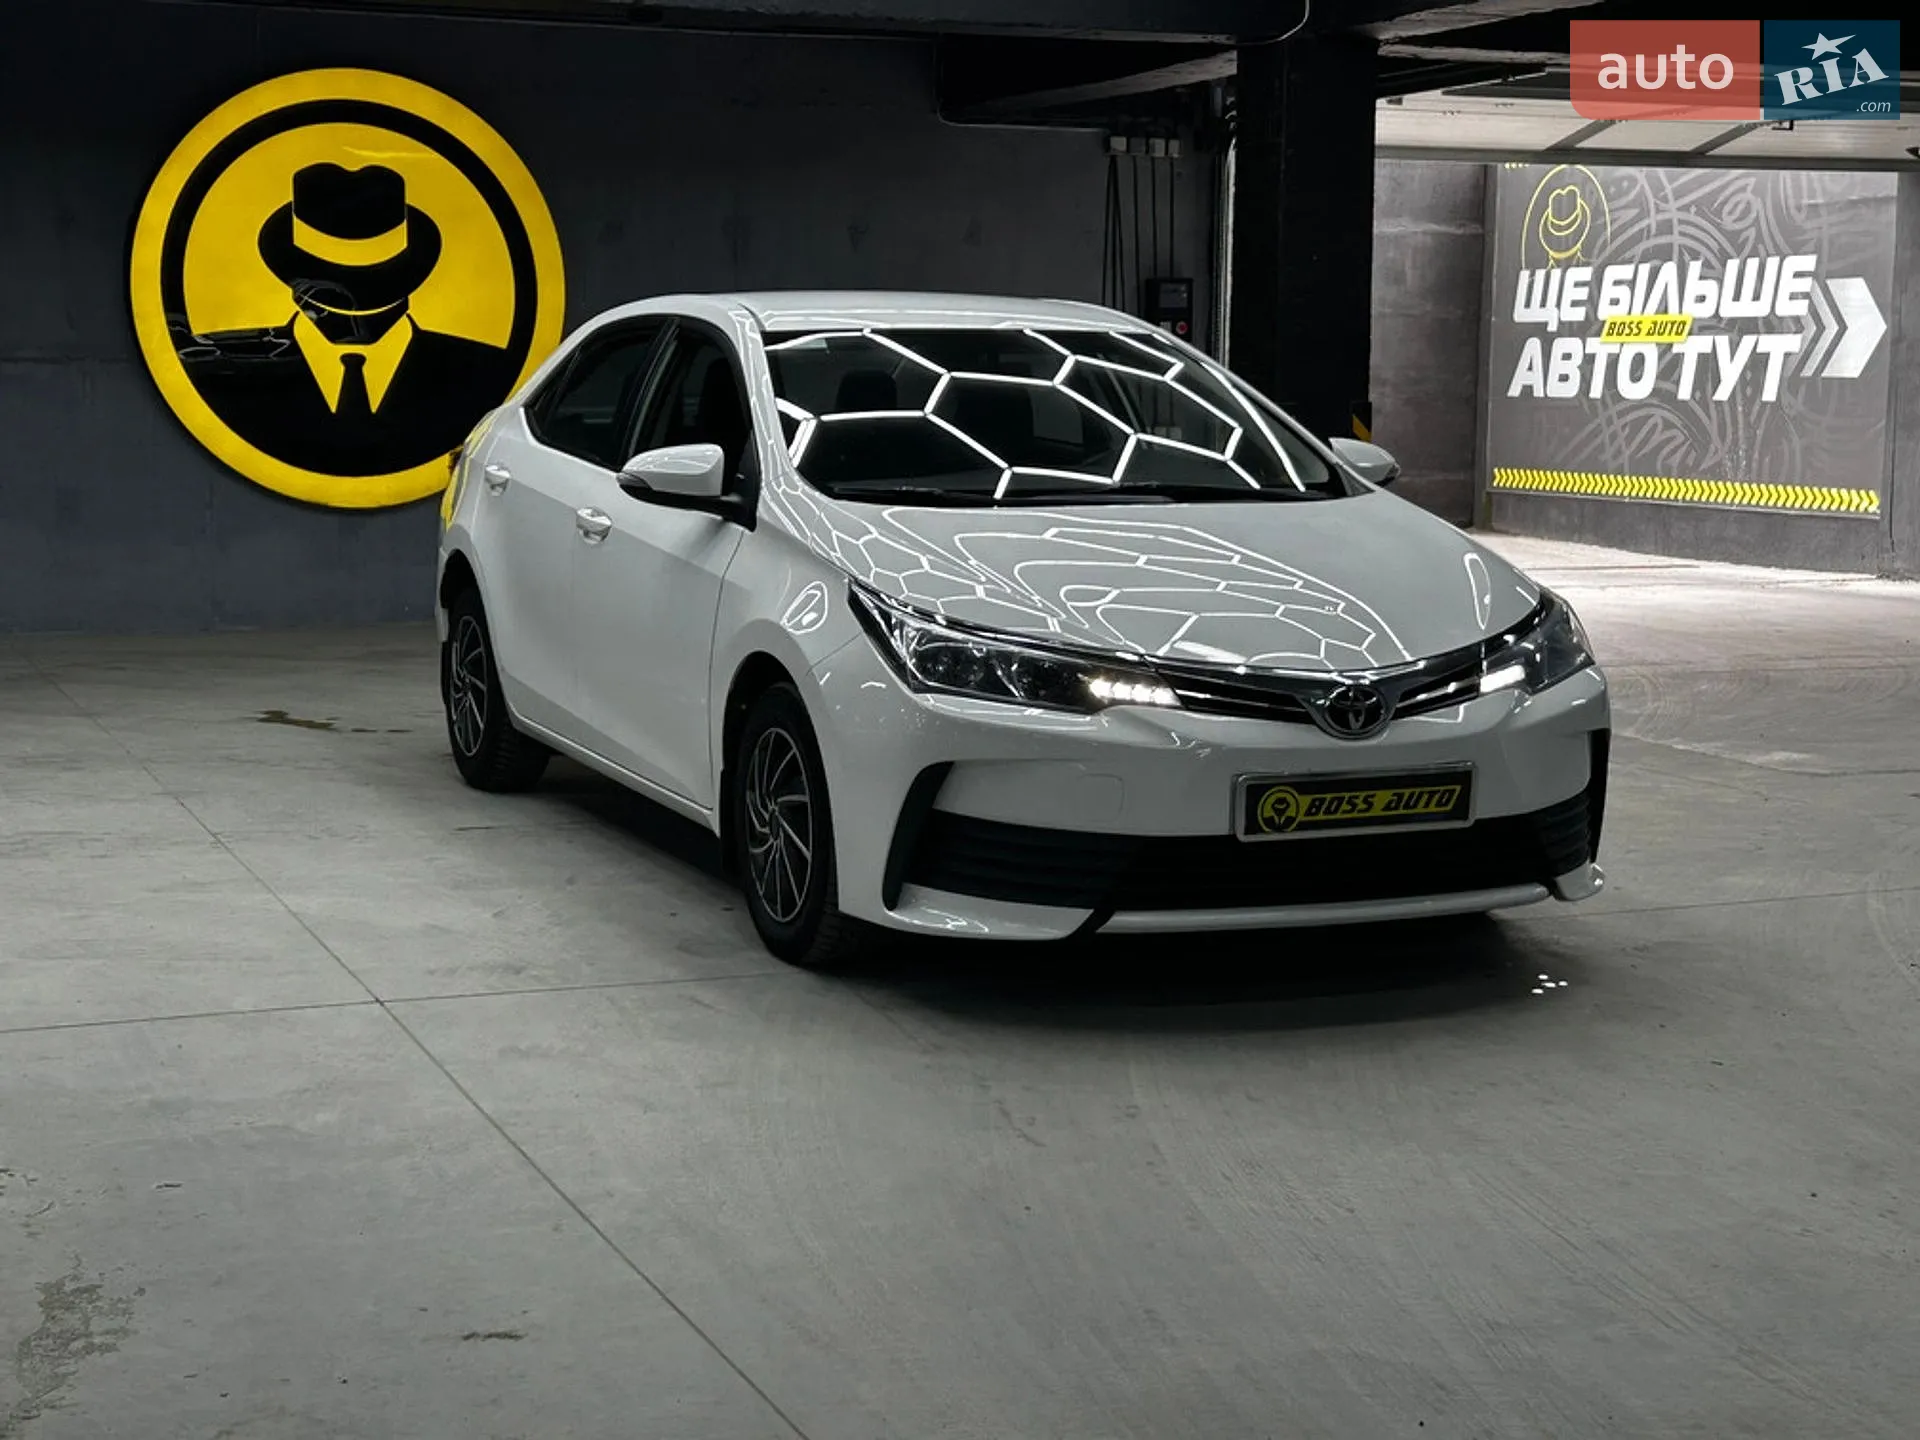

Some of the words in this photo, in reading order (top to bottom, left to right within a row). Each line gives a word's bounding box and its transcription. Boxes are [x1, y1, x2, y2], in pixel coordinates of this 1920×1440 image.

[1513, 267, 1593, 332] ЩЕ
[1597, 254, 1817, 318] БІЛЬШЕ
[1606, 321, 1643, 337] BOSS
[1645, 320, 1687, 337] AUTO
[1507, 337, 1659, 400] АВТО
[1672, 334, 1803, 402] ТУТ
[1304, 794, 1376, 817] BOSS
[1381, 789, 1456, 811] AUTO
